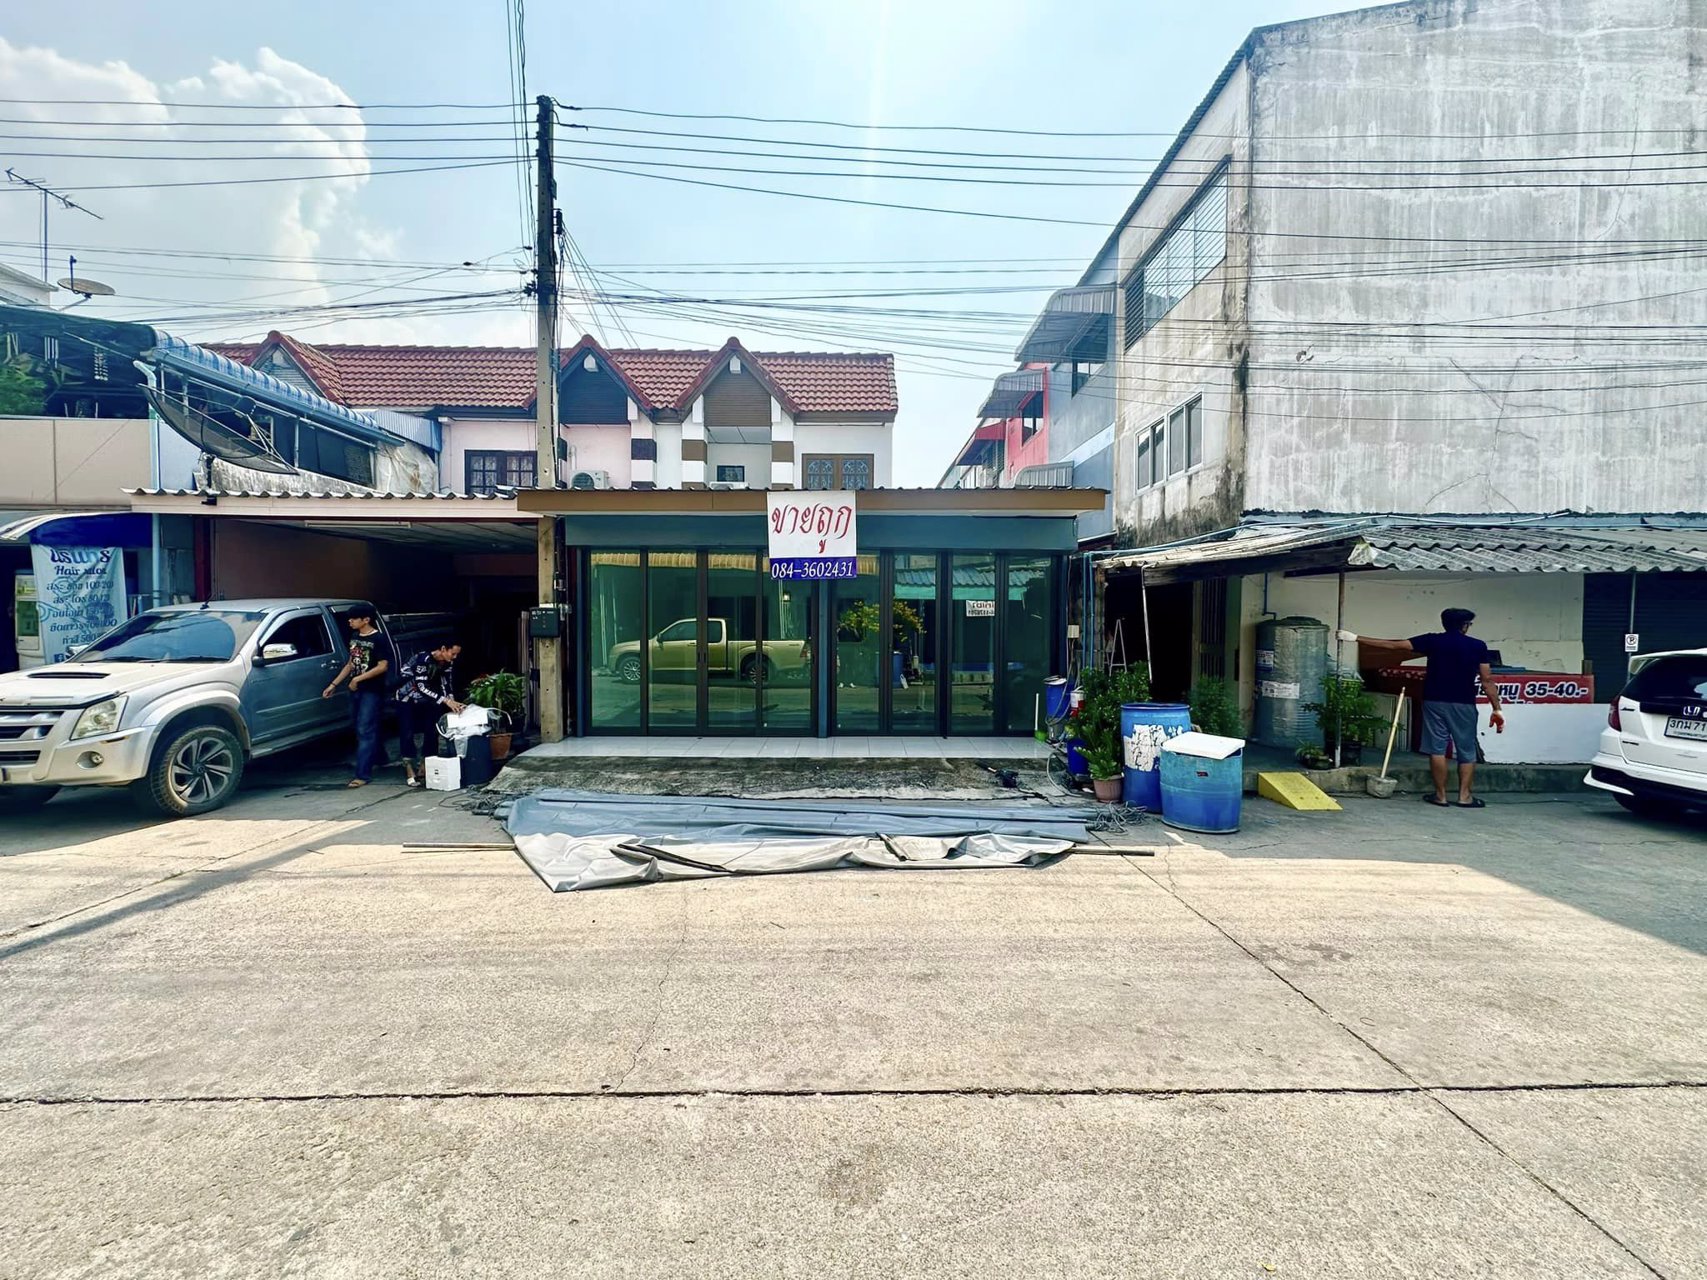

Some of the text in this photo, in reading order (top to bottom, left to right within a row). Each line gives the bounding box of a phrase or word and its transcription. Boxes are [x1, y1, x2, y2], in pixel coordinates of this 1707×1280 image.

[771, 502, 852, 554] ขายถูก
[54, 565, 80, 575] Hair
[771, 561, 853, 578] 084-3602431
[1525, 682, 1588, 698] 35-40.-
